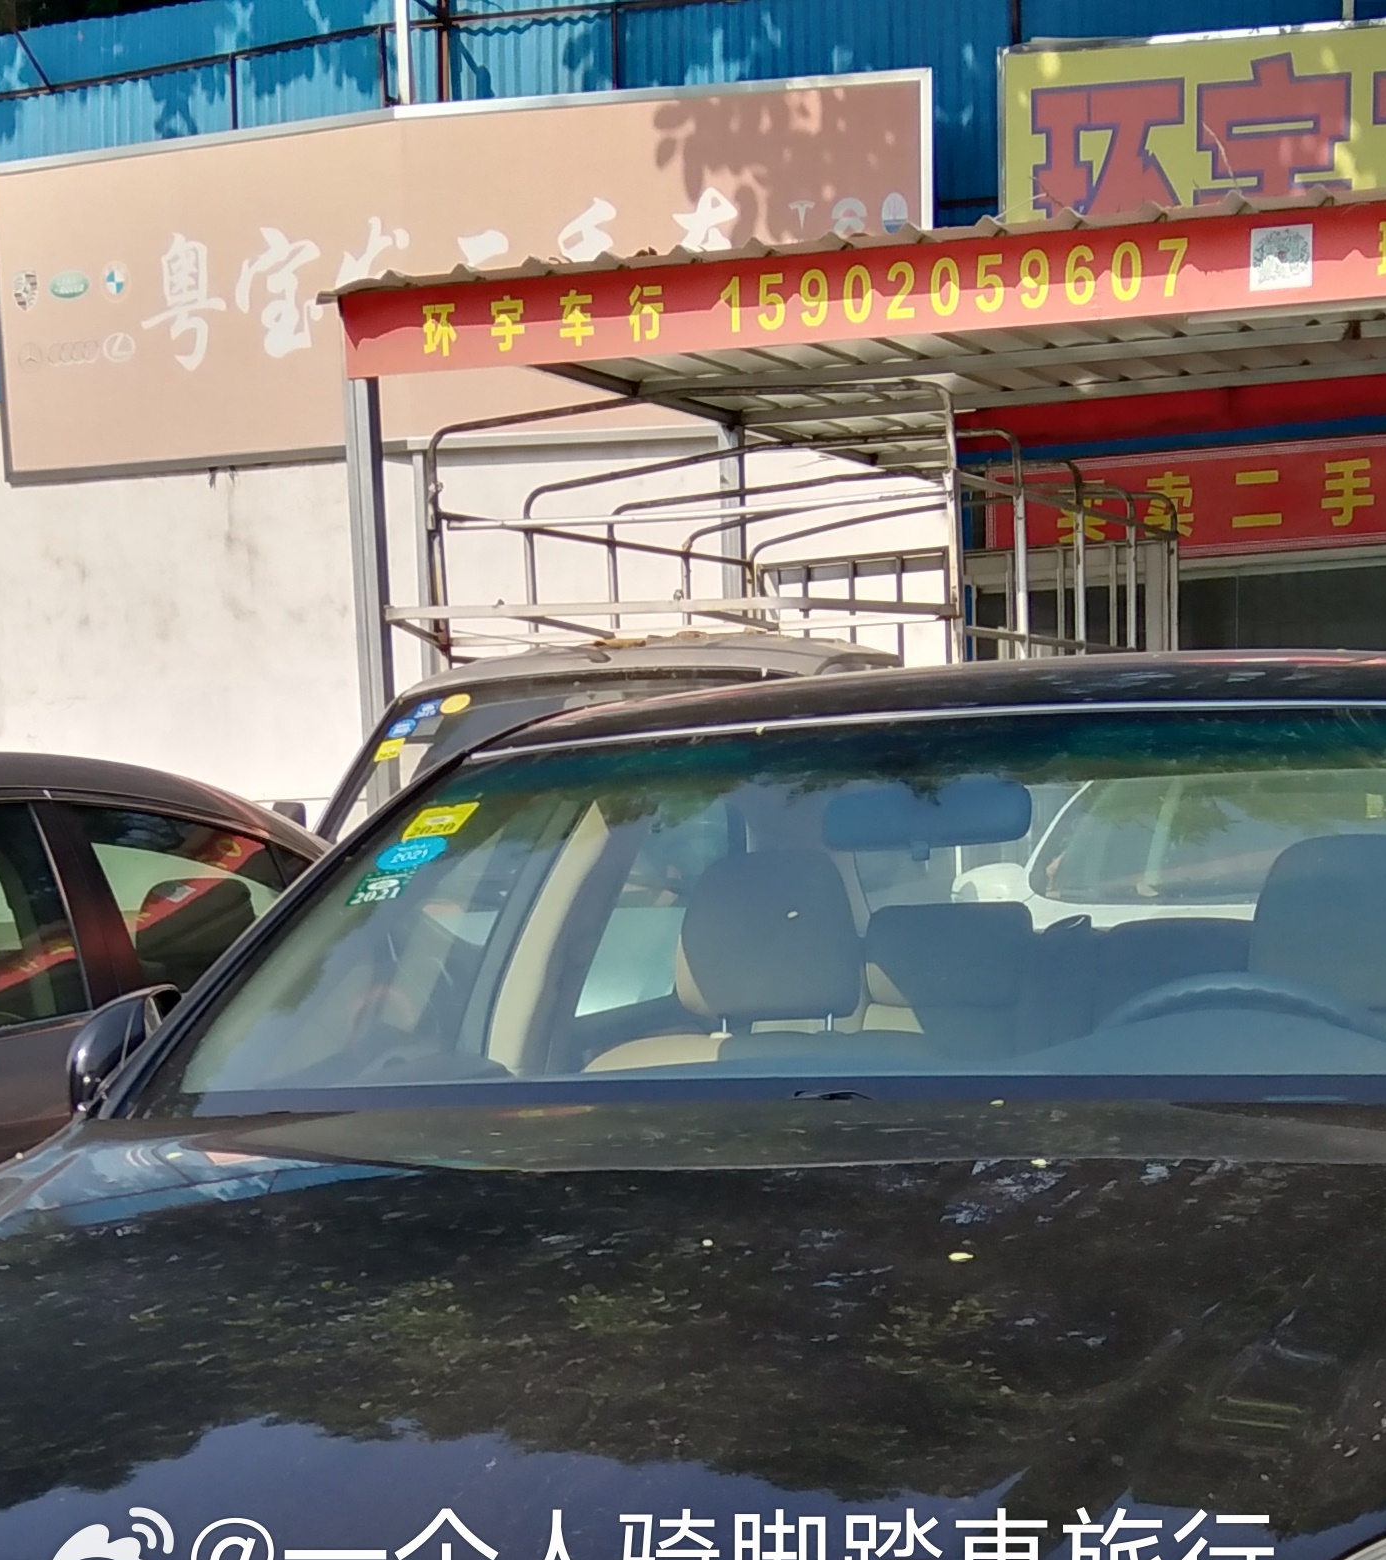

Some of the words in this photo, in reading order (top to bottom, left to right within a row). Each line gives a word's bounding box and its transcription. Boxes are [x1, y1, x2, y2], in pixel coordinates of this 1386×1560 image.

[422, 284, 665, 358] 环宇车行
[719, 237, 1189, 333] 15902059607
[409, 822, 456, 837] 2020
[349, 886, 401, 905] 2021
